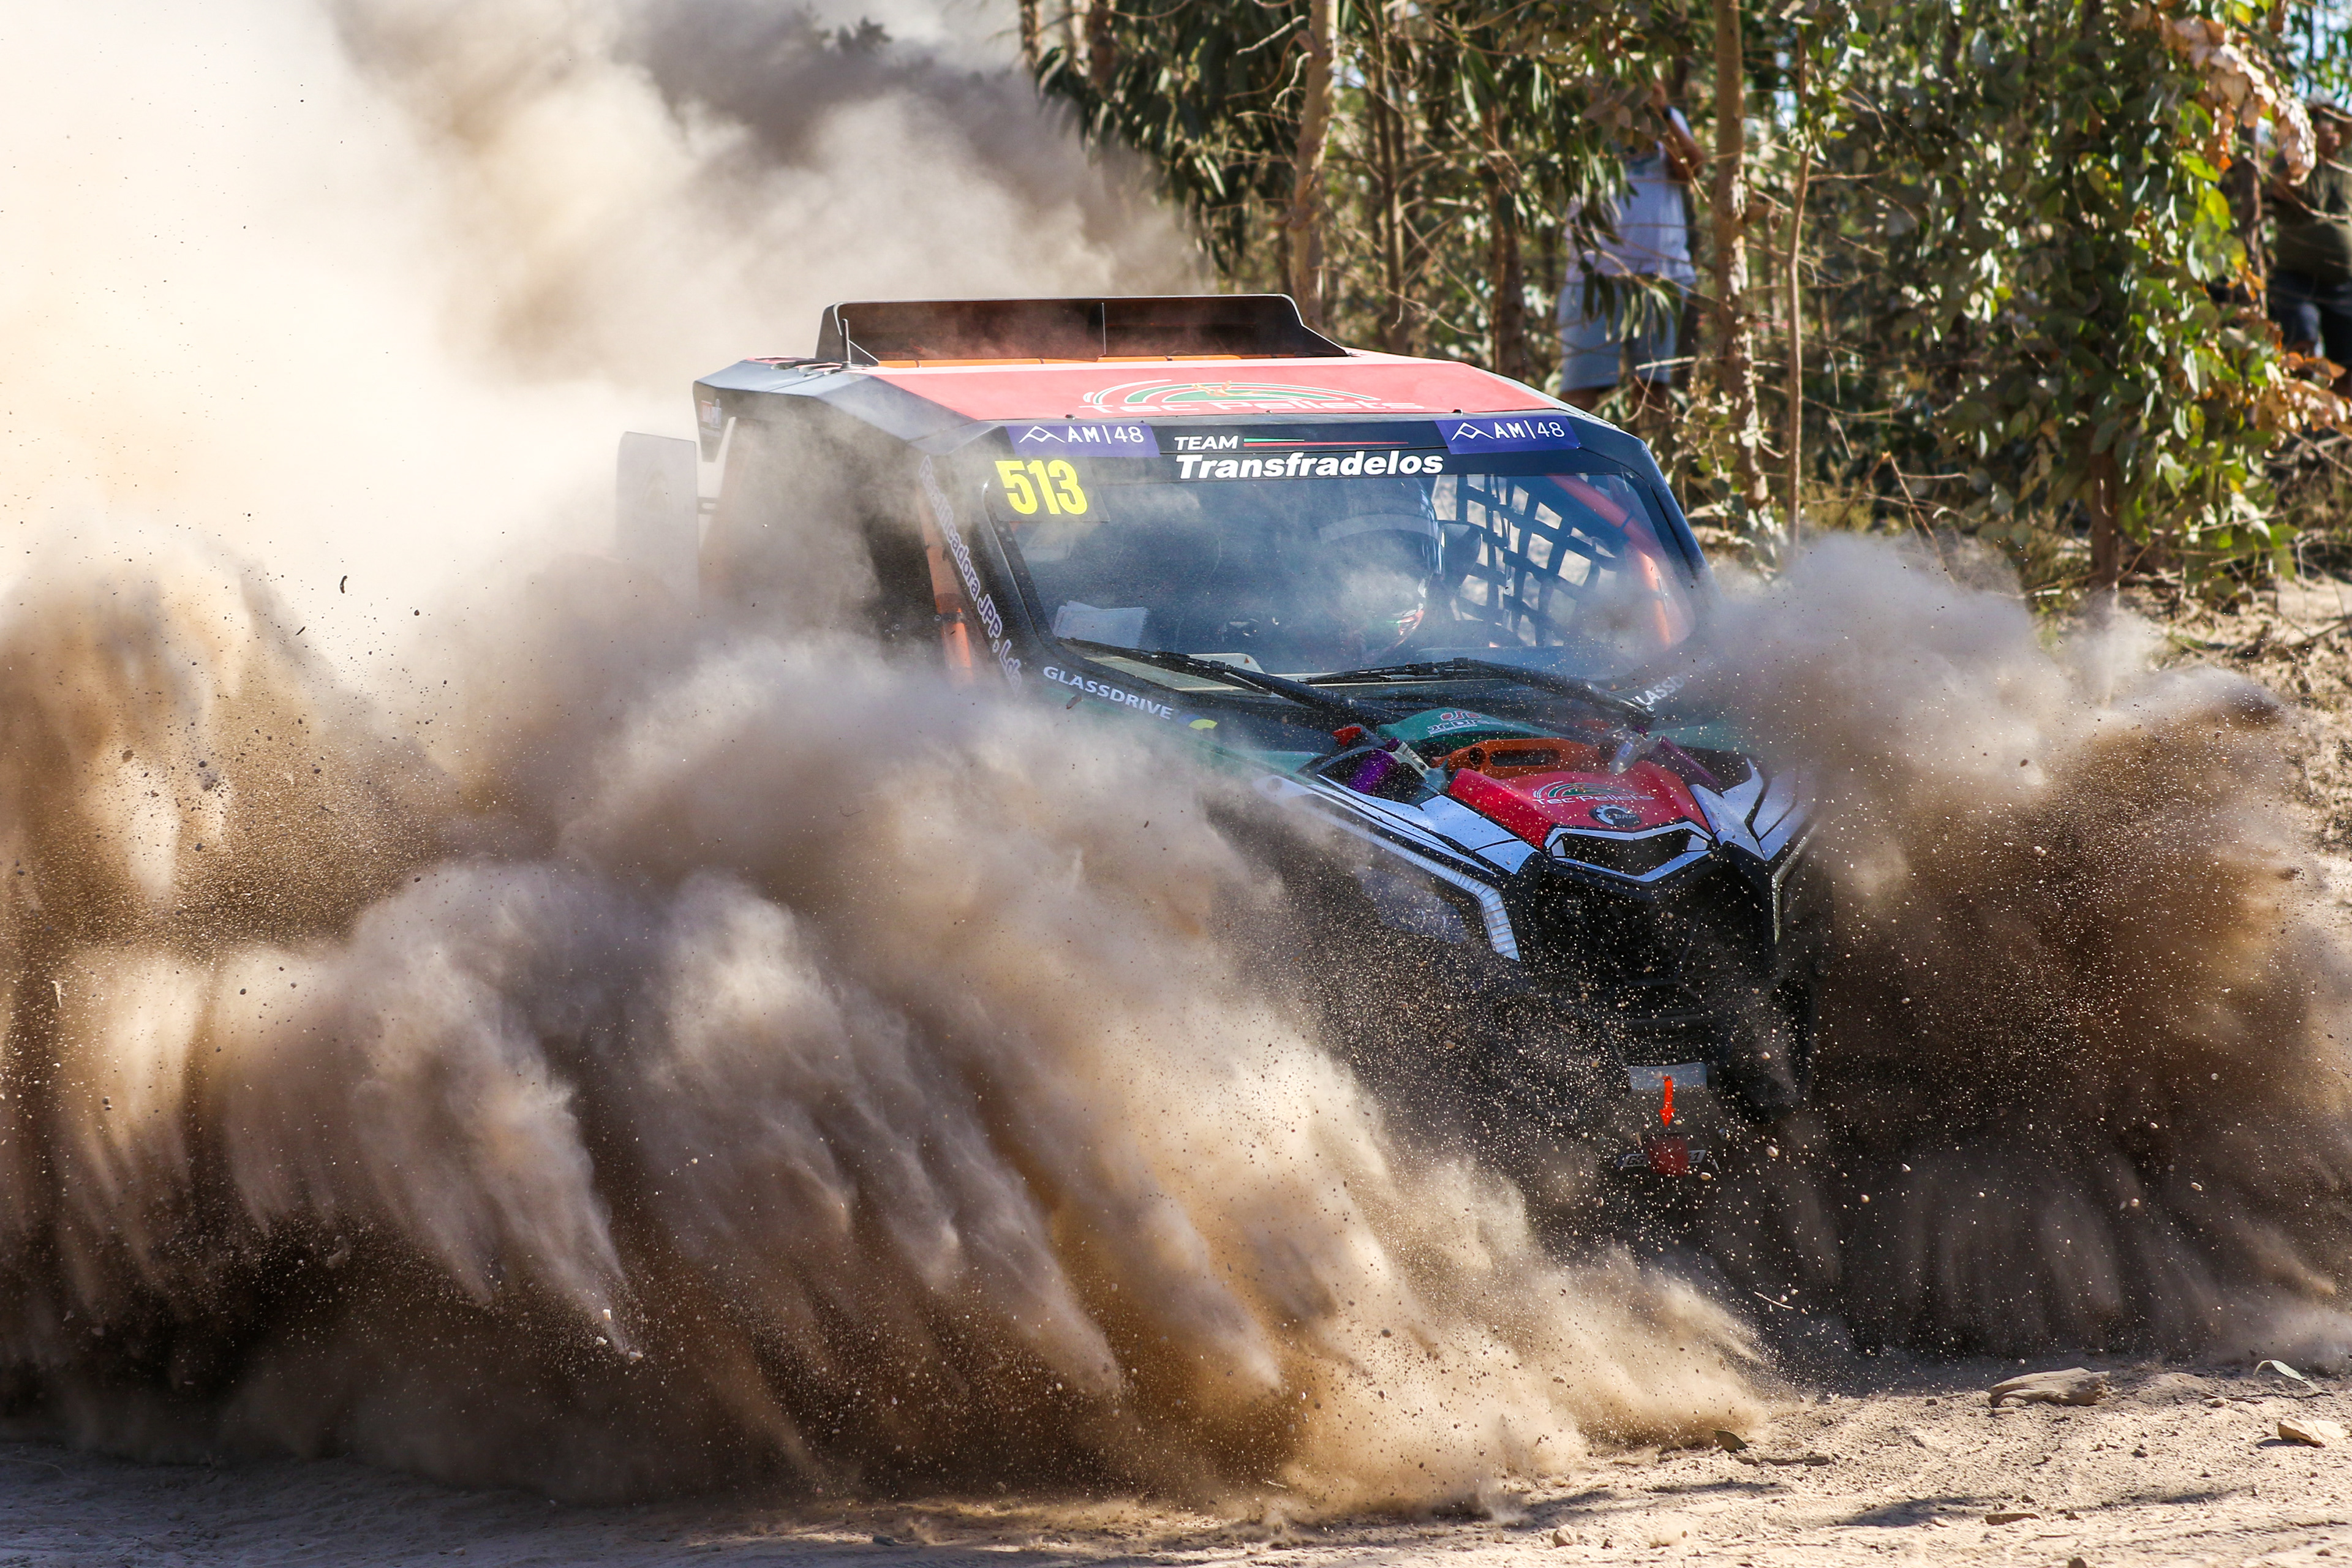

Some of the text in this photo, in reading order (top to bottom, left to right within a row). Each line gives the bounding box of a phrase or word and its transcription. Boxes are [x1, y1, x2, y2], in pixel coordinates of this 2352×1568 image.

[1079, 403, 1200, 413] Tec
[1174, 435, 1238, 451] TEAM
[1175, 451, 1444, 480] Transfradelos
[995, 459, 1088, 514] 513
[1042, 666, 1175, 720] GLASSDRIVE
